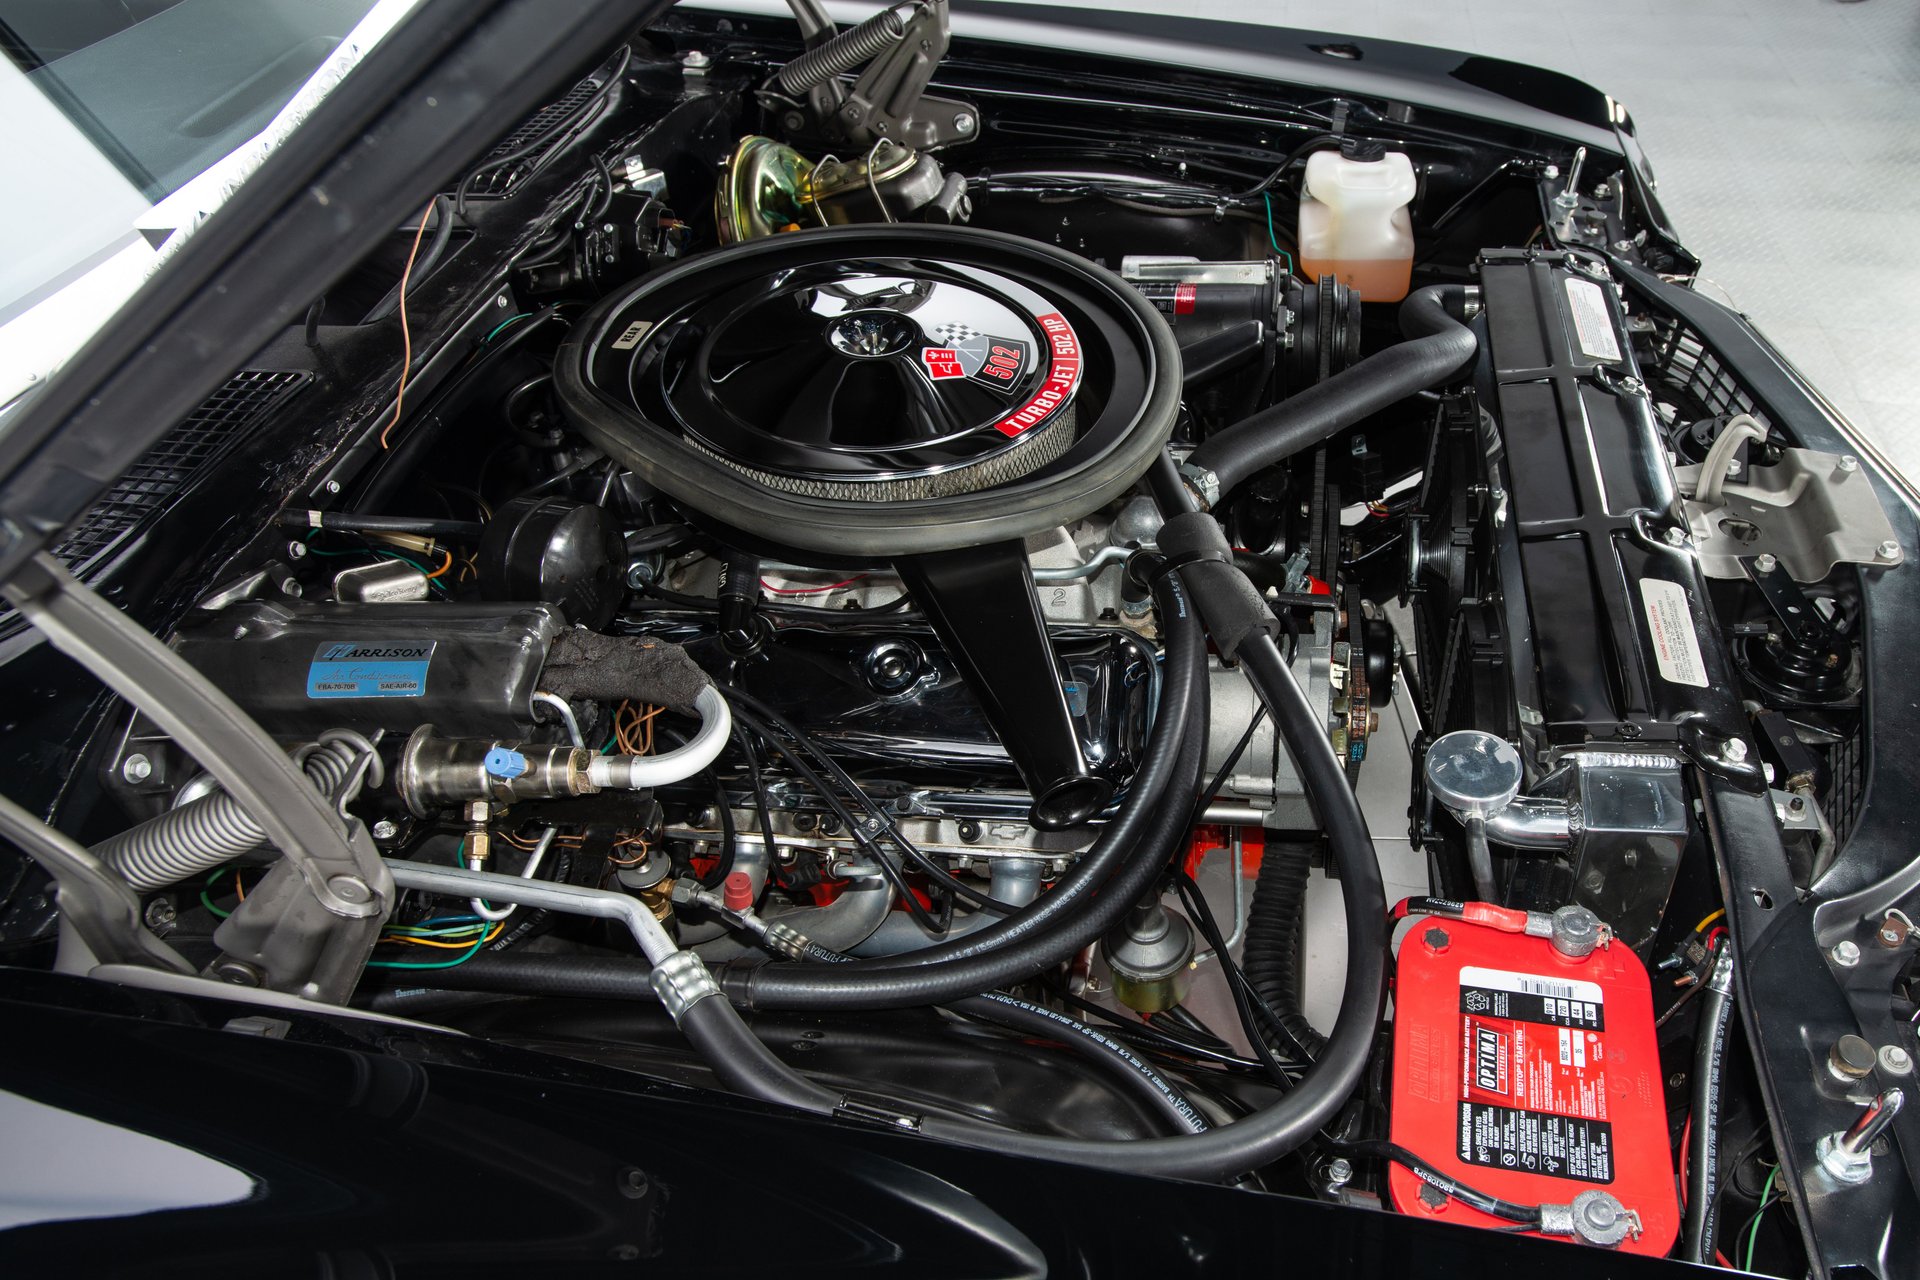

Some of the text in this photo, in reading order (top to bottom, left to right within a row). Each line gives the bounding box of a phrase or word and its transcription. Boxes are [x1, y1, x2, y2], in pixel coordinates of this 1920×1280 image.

[621, 327, 642, 342] REAR
[1043, 319, 1075, 355] 502 HP
[982, 345, 1020, 379] 502
[1005, 365, 1075, 430] TURBO-JET
[1051, 588, 1066, 606] 2
[1655, 623, 1664, 643] COOLING
[322, 645, 428, 660] HARRISON
[1659, 644, 1669, 661] ENGINE
[1007, 919, 1035, 939] HEATER
[1034, 908, 1052, 923] HOSE
[1052, 897, 1069, 912] MADE
[1035, 1007, 1050, 1016] MADE
[1545, 1004, 1553, 1014] 910
[1559, 1005, 1567, 1016] 720
[1720, 1001, 1731, 1022] BARRIER
[1717, 1023, 1725, 1036] A/C
[1715, 1038, 1723, 1052] HOSE
[1129, 1056, 1142, 1069] HOSE
[1480, 1033, 1496, 1087] OPTIMA
[1151, 1075, 1170, 1093] BARRIER
[1174, 1097, 1207, 1133] FUTURA
[1708, 1158, 1716, 1173] MADE
